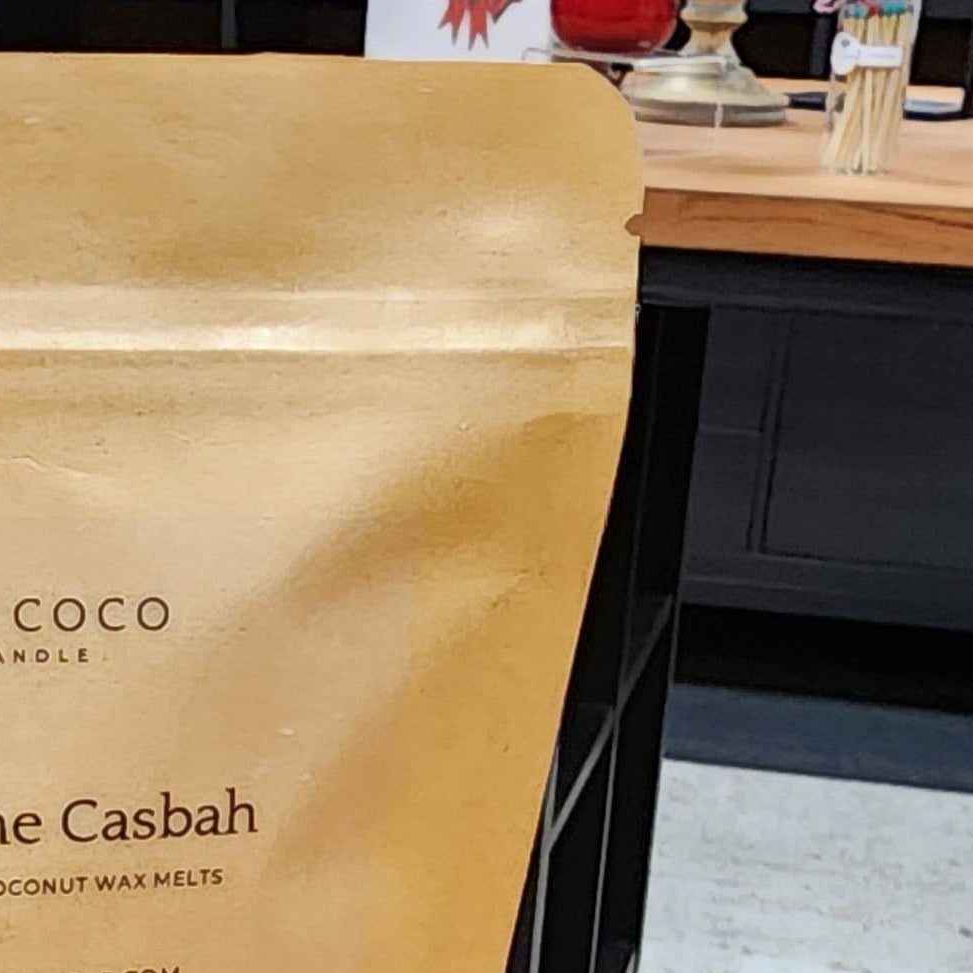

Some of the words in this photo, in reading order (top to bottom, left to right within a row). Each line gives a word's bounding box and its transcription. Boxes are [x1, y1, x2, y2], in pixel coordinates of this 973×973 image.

[14, 597, 170, 632] COCO
[61, 787, 258, 842] Casbah
[94, 873, 147, 892] WAX
[153, 868, 224, 888] MELTS
